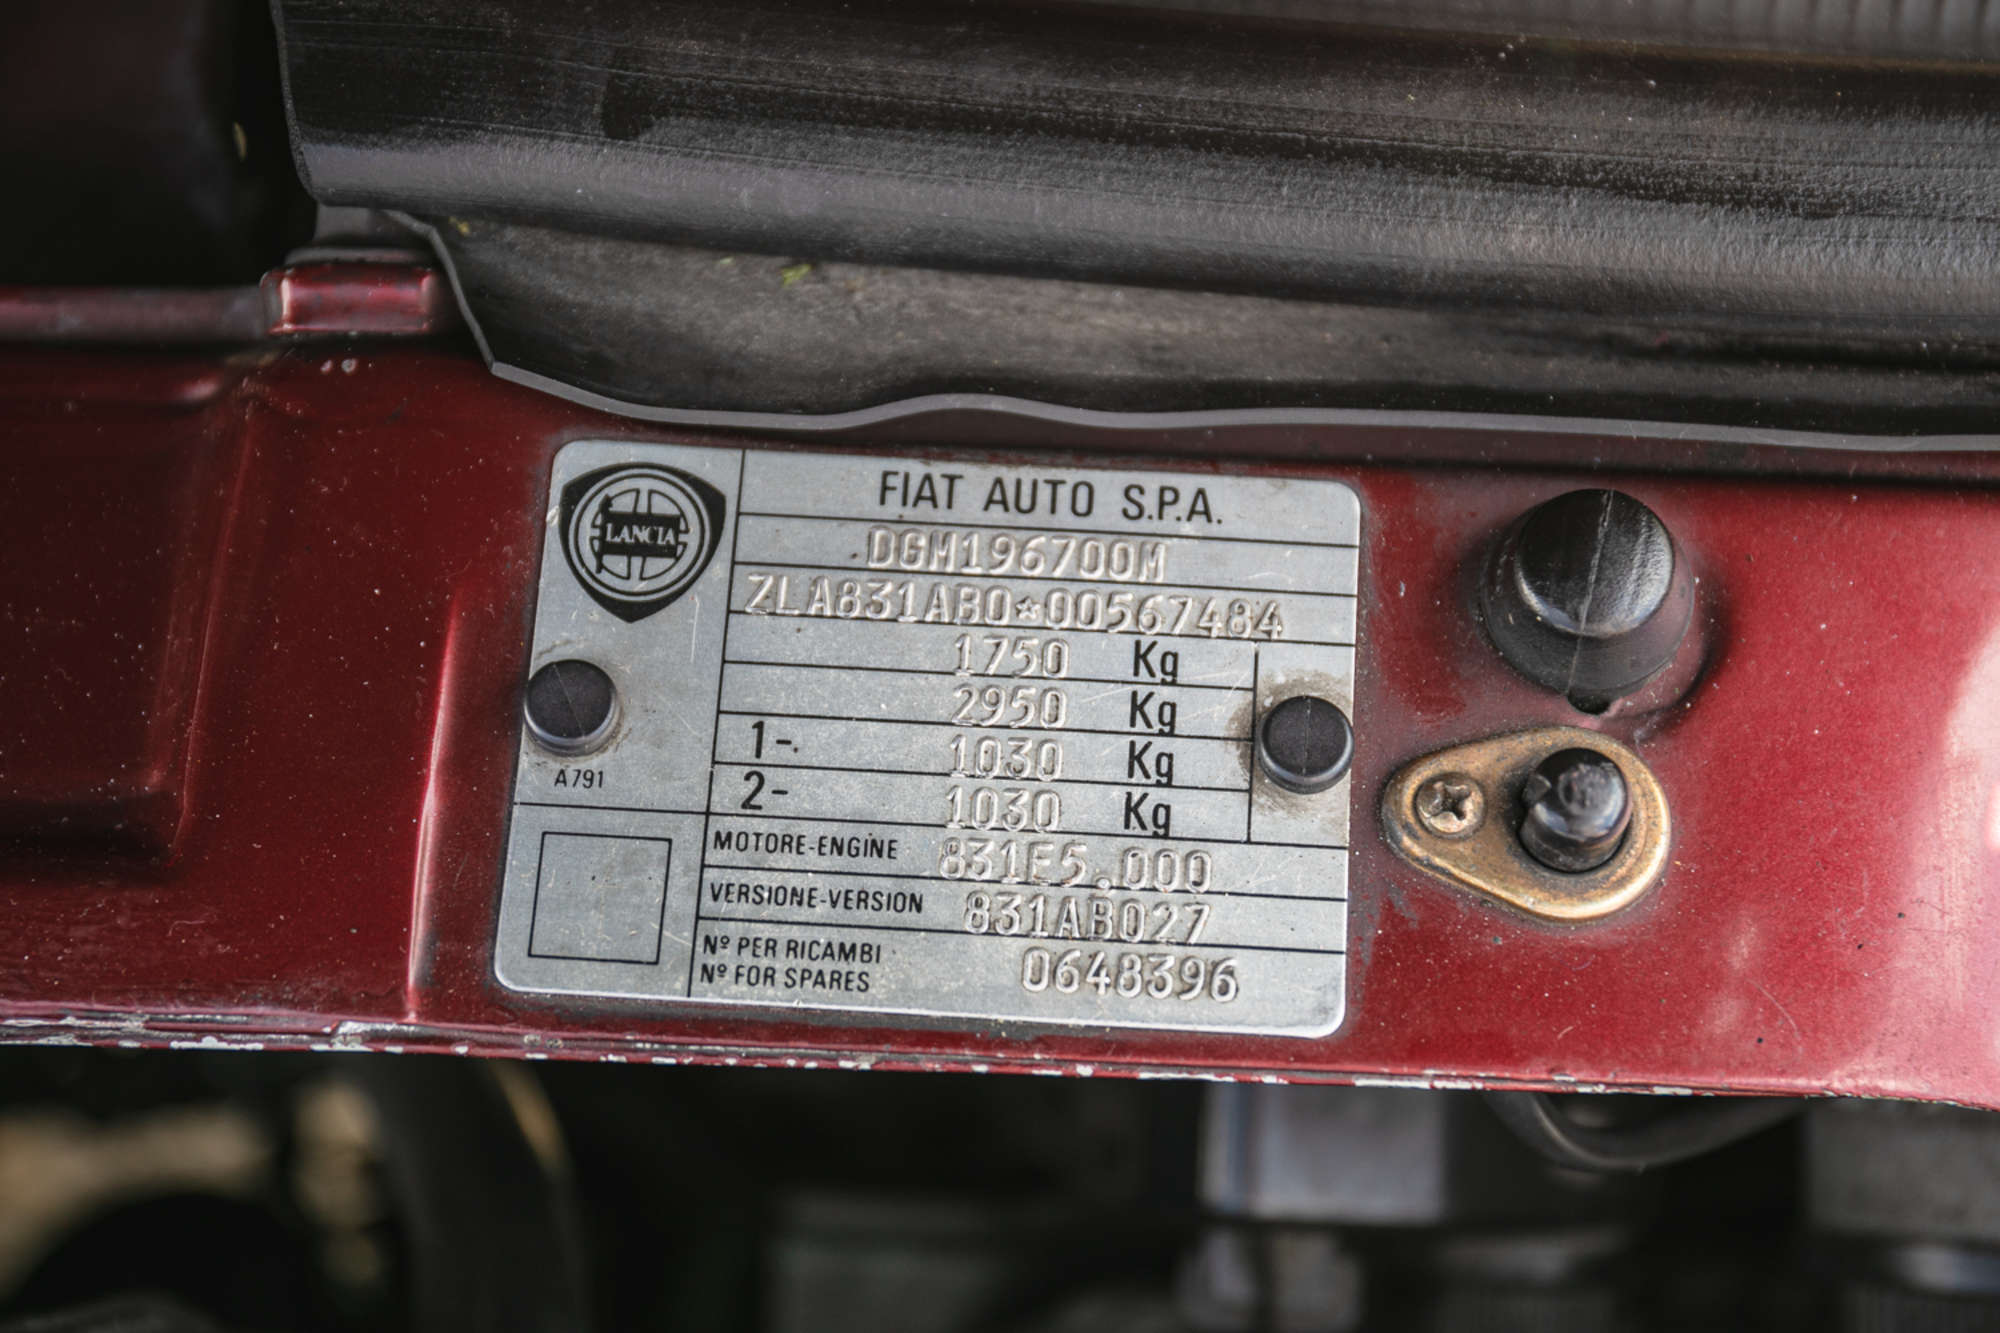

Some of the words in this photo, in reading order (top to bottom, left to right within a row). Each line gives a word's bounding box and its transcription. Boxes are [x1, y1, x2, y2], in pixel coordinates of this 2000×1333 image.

[879, 470, 964, 510] FIAT
[983, 476, 1096, 518] AUTO
[1121, 483, 1224, 526] S.P.A.
[604, 521, 678, 547] LANCIA
[867, 525, 1169, 584] DGM196700M
[954, 633, 1070, 680] 1750
[1133, 639, 1180, 685] Kg
[951, 684, 1068, 730] 2950
[1129, 690, 1178, 735] Kg
[948, 733, 1065, 781] 1030
[1127, 739, 1175, 787] Kg
[945, 784, 1062, 832] 1030
[1123, 791, 1172, 838] Kg
[713, 830, 899, 860] MOTORE-ENGINE
[709, 882, 924, 914] VERSIONE-VERSION
[963, 890, 1212, 945] 831AB027
[737, 936, 778, 959] PER
[784, 939, 882, 964] RICAMBI
[1021, 945, 1240, 1003] 0648396
[734, 965, 777, 988] FOR
[784, 967, 871, 993] SPARES
